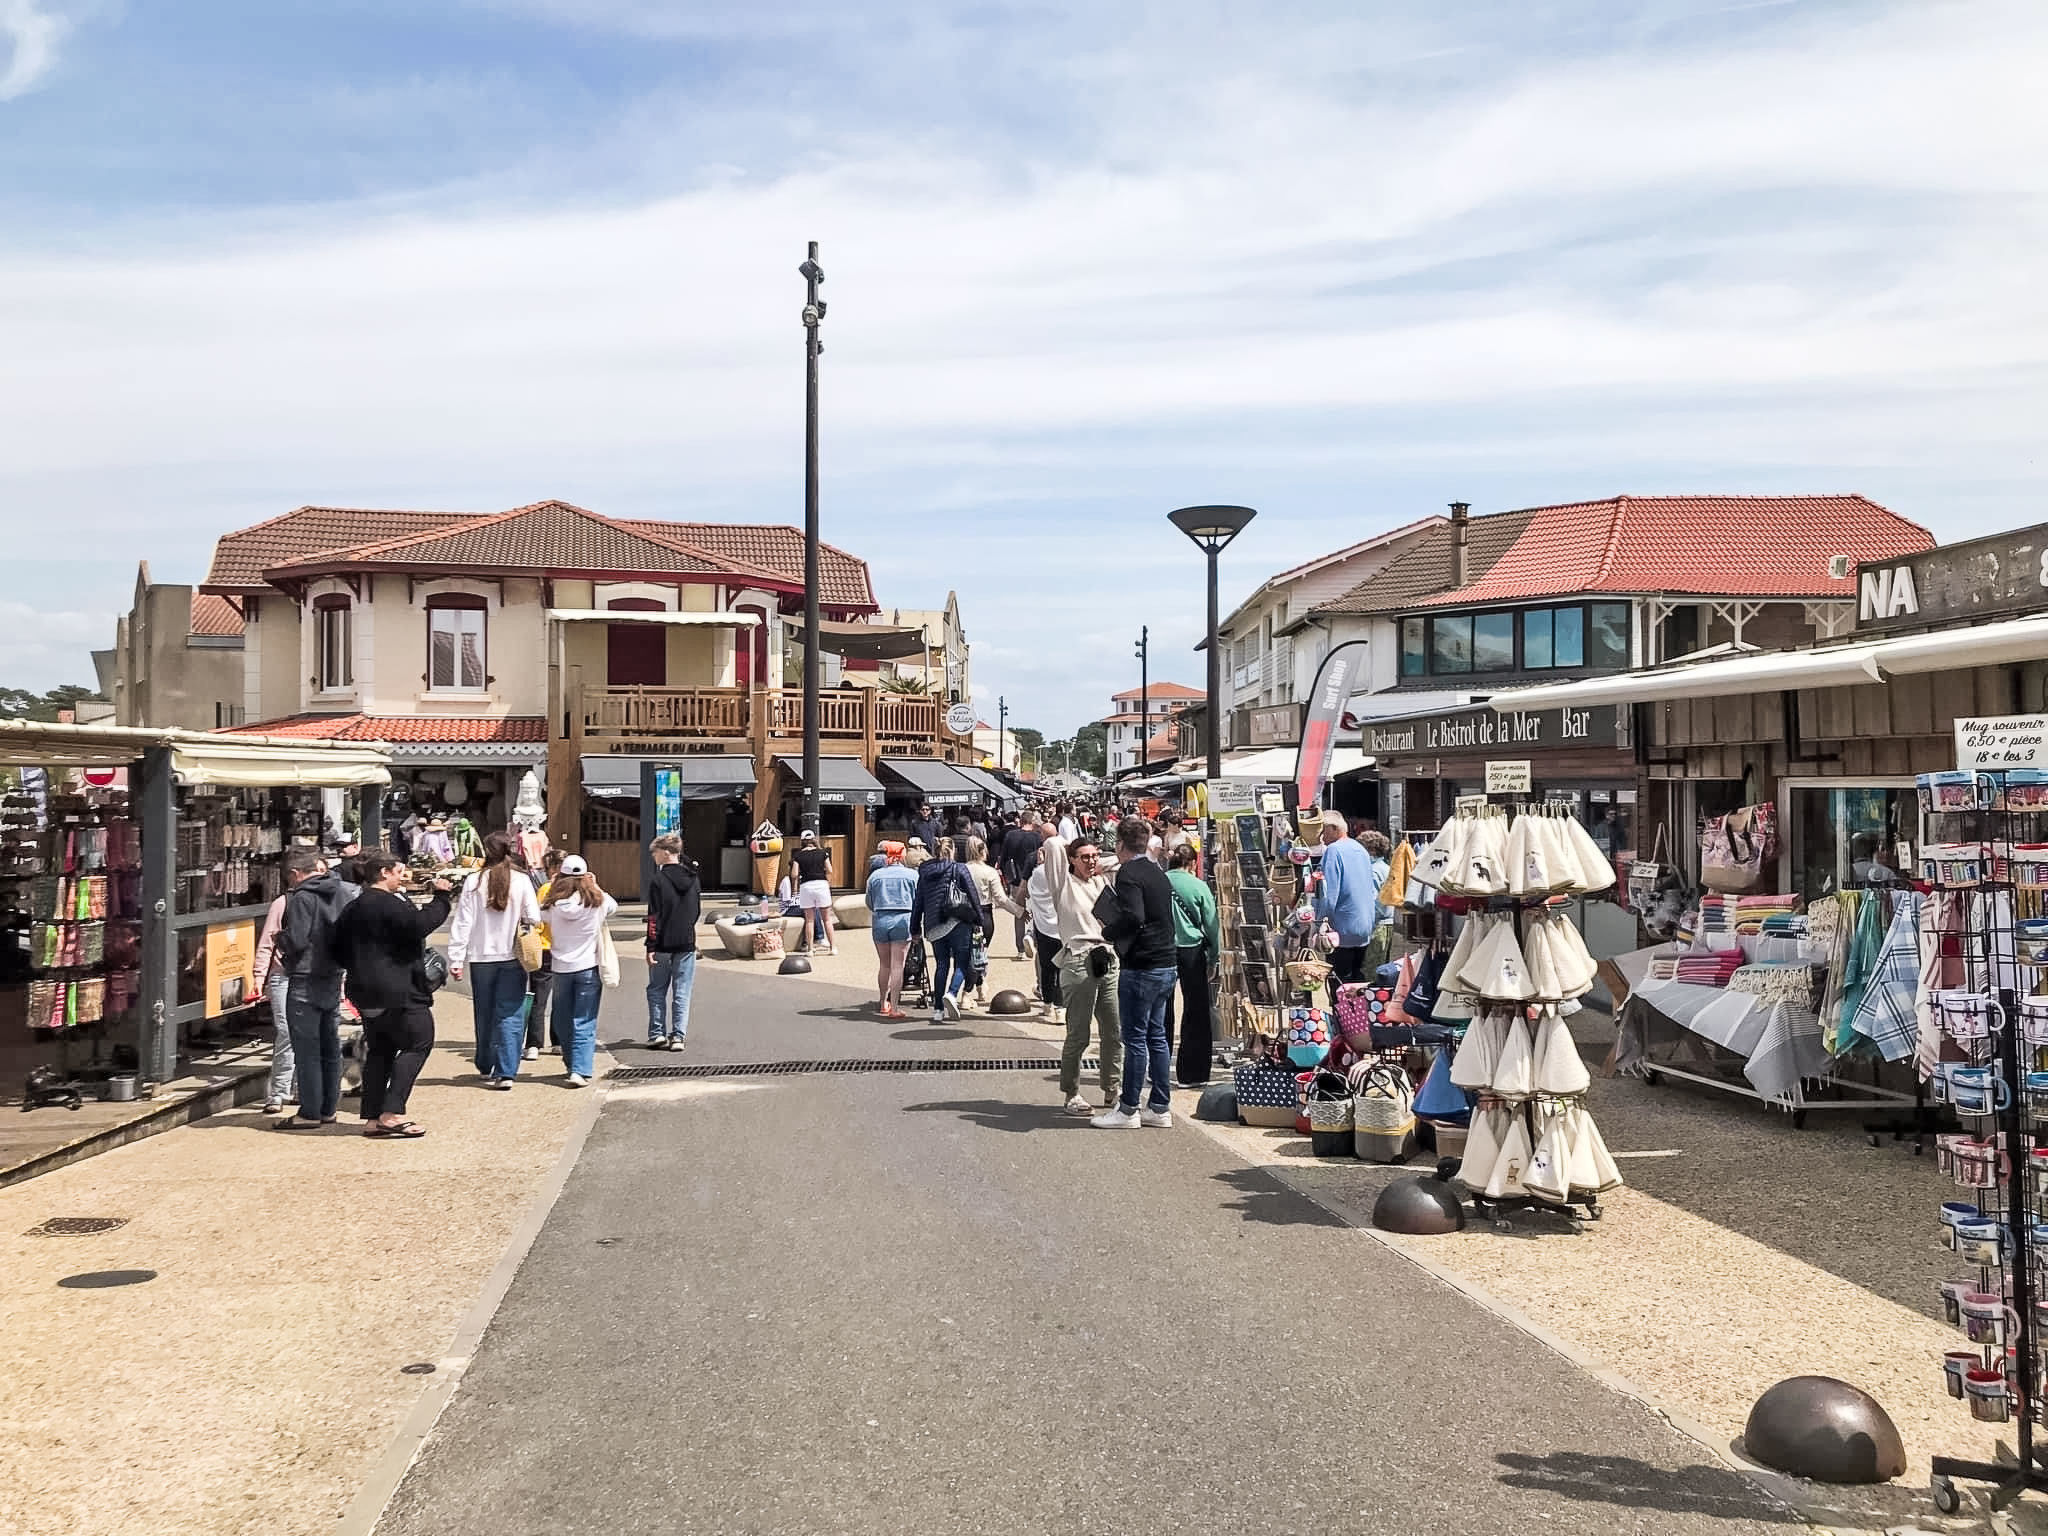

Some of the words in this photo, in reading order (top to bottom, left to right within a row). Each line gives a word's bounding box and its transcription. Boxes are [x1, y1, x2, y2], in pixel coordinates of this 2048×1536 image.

[1328, 659, 1347, 689] Shop
[1322, 686, 1340, 710] Surf
[1371, 725, 1415, 752] Restaurant
[1427, 722, 1438, 748] Le
[1440, 718, 1477, 746] Bistrot
[1479, 714, 1493, 744] de
[1497, 712, 1509, 743] la
[1512, 712, 1541, 742] Mer
[1561, 707, 1591, 738] Bar
[1961, 721, 1989, 735] Mug
[1992, 719, 2046, 731] souvenir
[609, 743, 622, 753] LA
[623, 743, 670, 753] TERRASSE
[1966, 734, 1996, 747] 6,50
[2008, 735, 2043, 748] pièce
[1975, 751, 1990, 763] 18
[2003, 750, 2022, 761] les
[2024, 749, 2036, 760] 3
